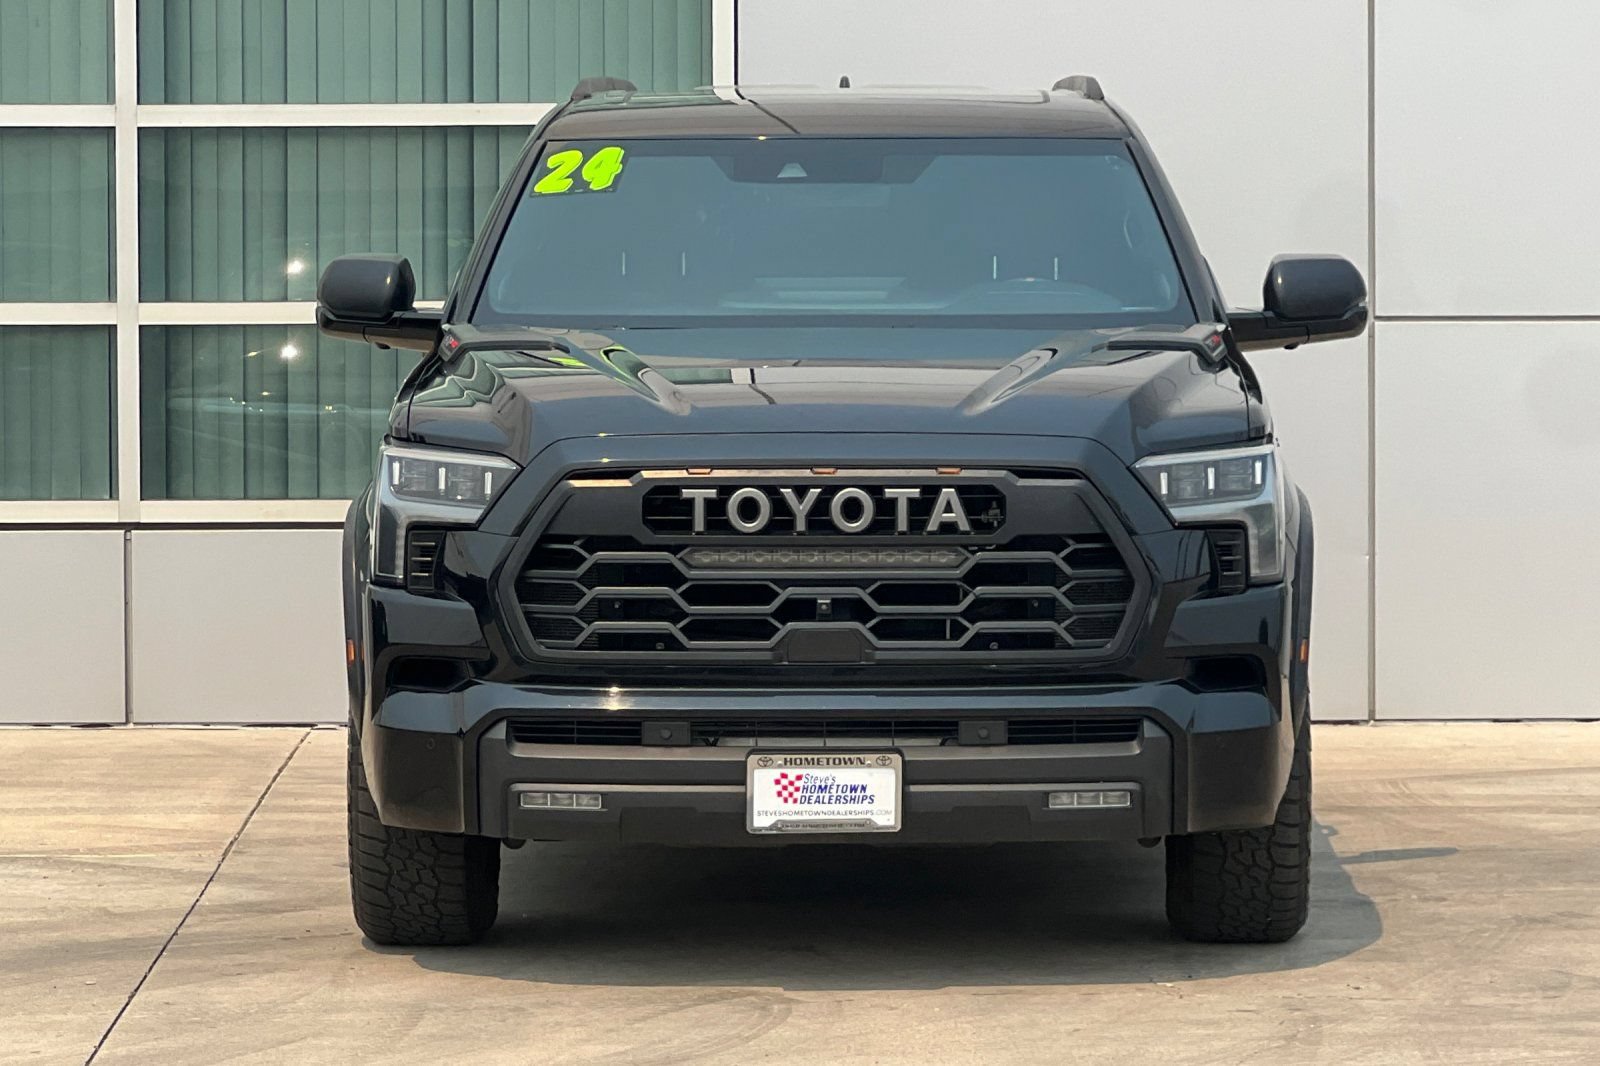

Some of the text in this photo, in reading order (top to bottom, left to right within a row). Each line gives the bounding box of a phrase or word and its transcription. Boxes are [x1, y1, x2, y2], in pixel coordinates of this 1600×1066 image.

[534, 147, 624, 193] 24
[681, 487, 971, 533] TOYOTA
[783, 757, 866, 767] HOMETOWN
[803, 773, 836, 784] Steve's
[801, 784, 868, 794] HOMETOWN
[799, 794, 875, 805] DEALERSHIPS
